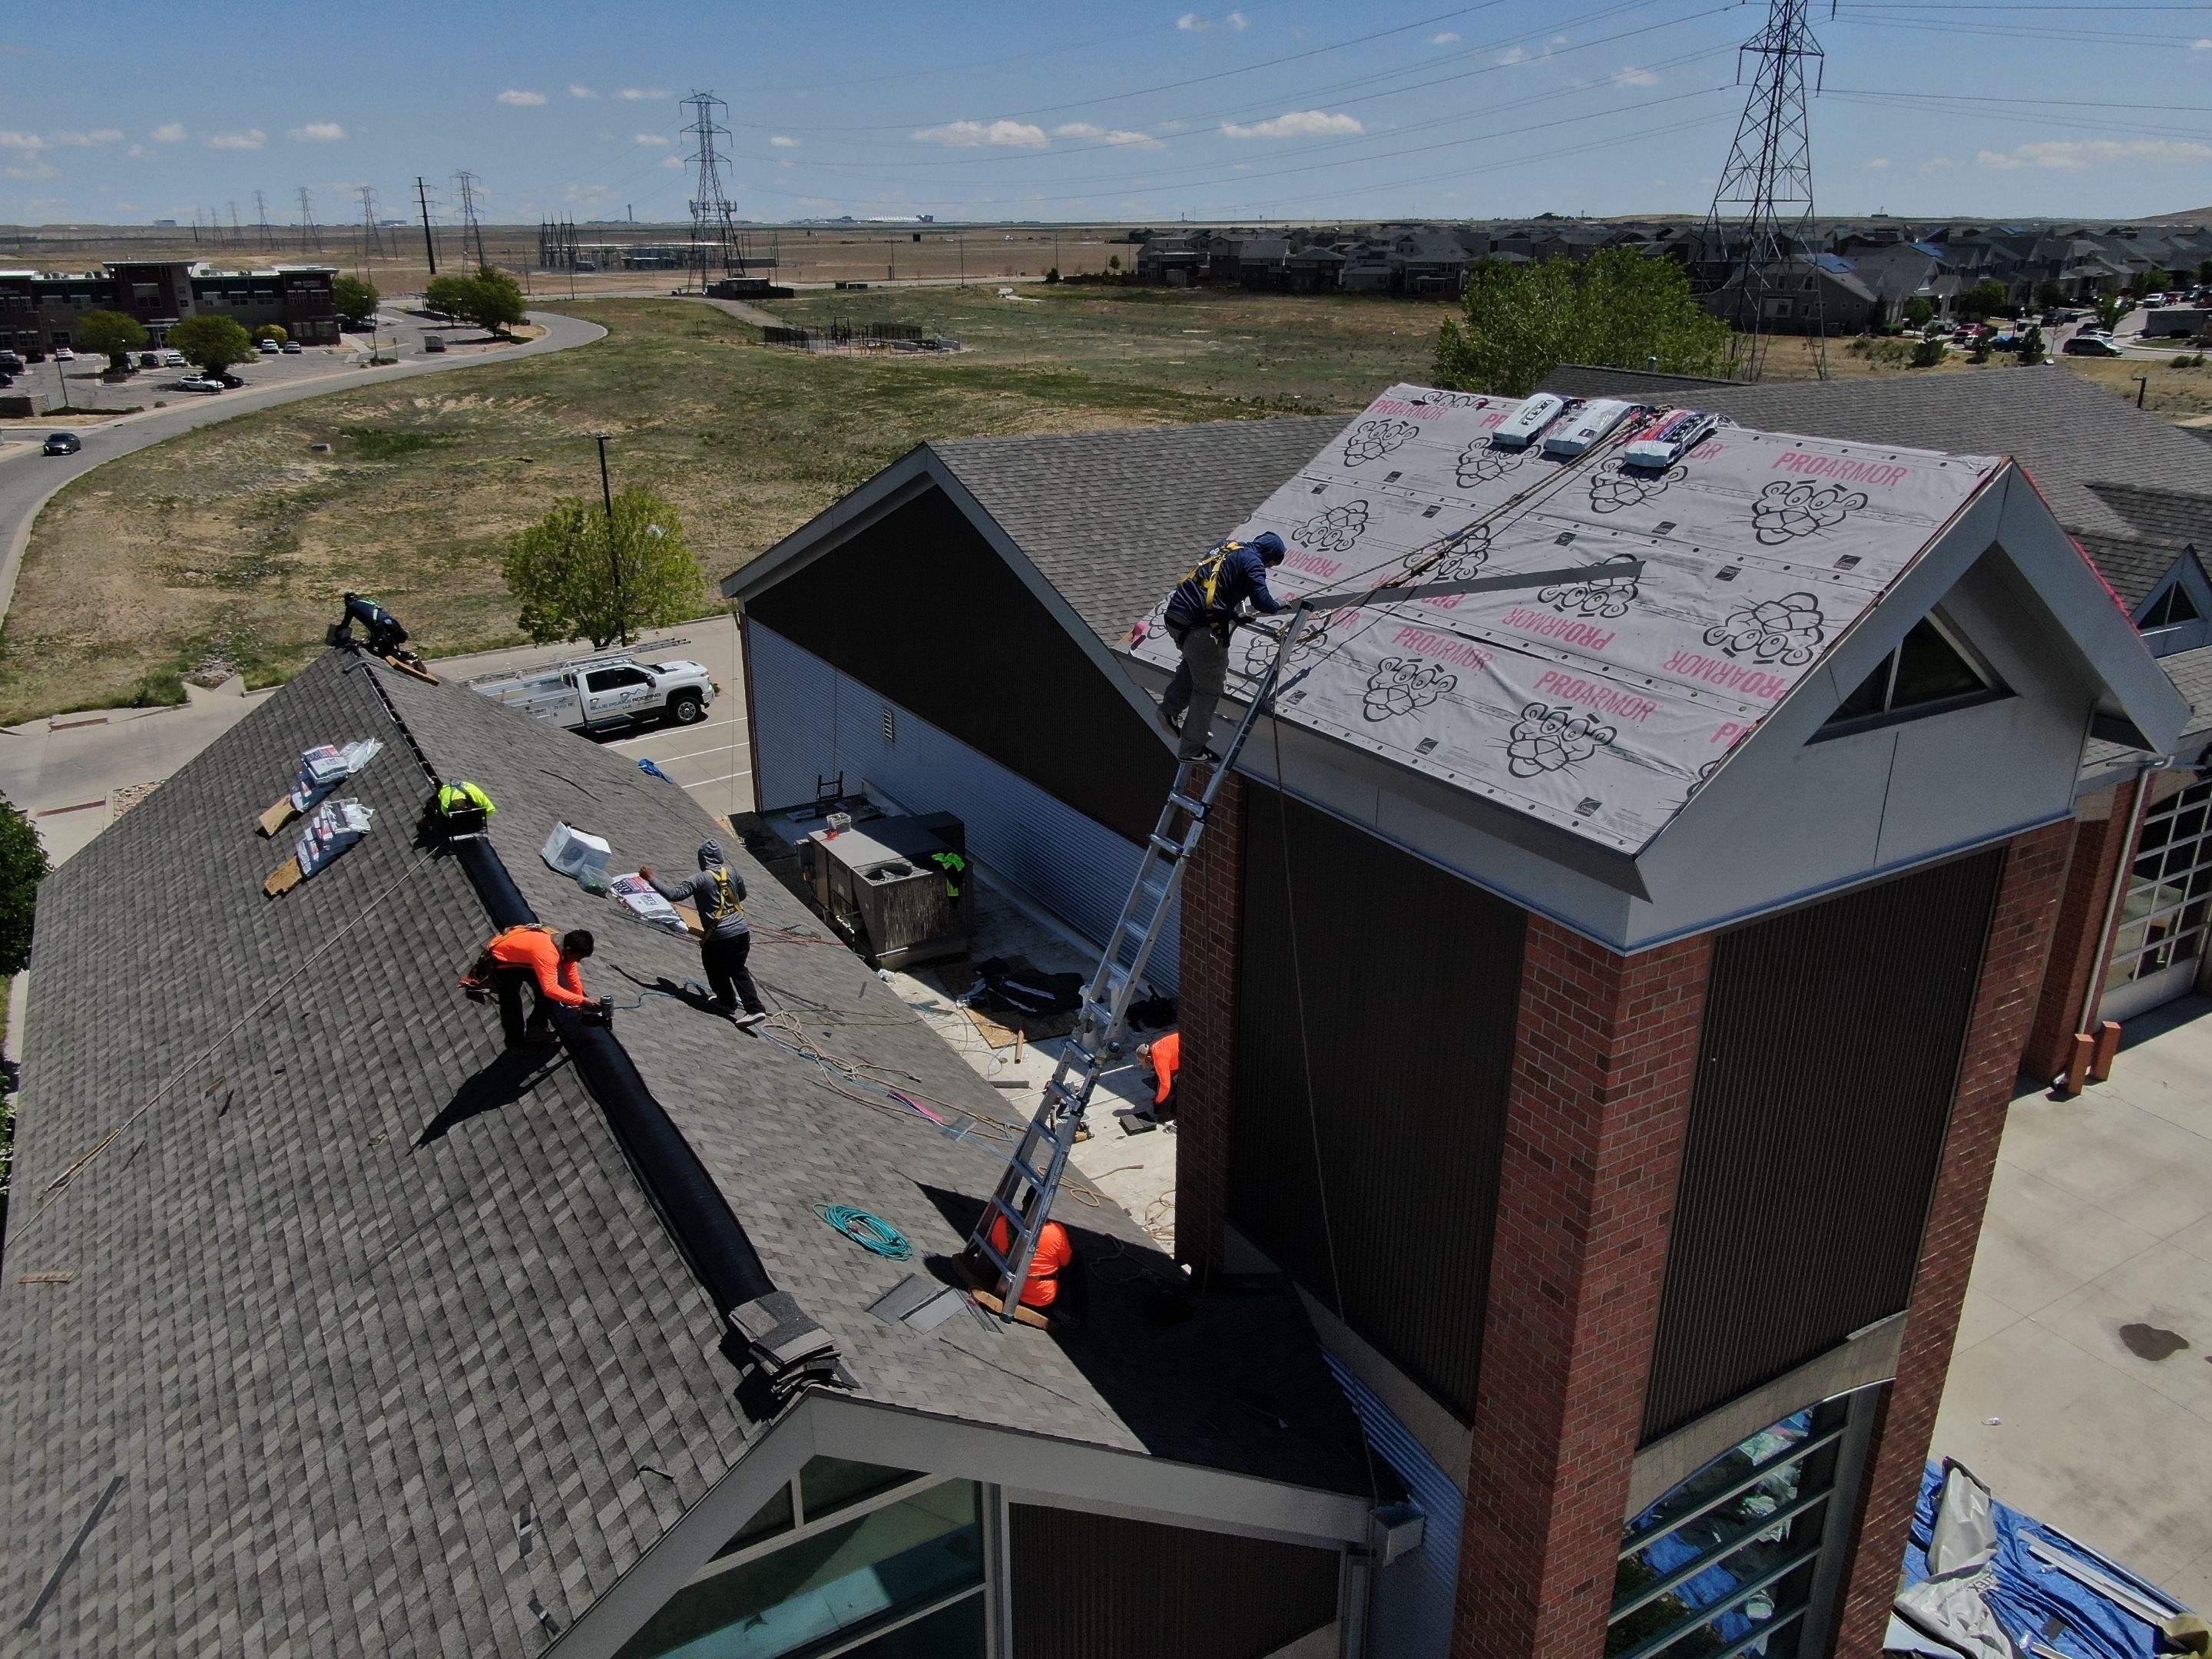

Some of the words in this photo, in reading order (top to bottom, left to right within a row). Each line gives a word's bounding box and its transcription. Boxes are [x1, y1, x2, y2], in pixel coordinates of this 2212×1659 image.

[1369, 399, 1448, 422] PROARMOR
[1771, 452, 1909, 486] PROARMOR
[1283, 549, 1343, 578] PROARM
[1392, 626, 1496, 671] PROARMOR
[1502, 608, 1617, 651] PROARMOR
[1533, 671, 1658, 724] PROARMOR
